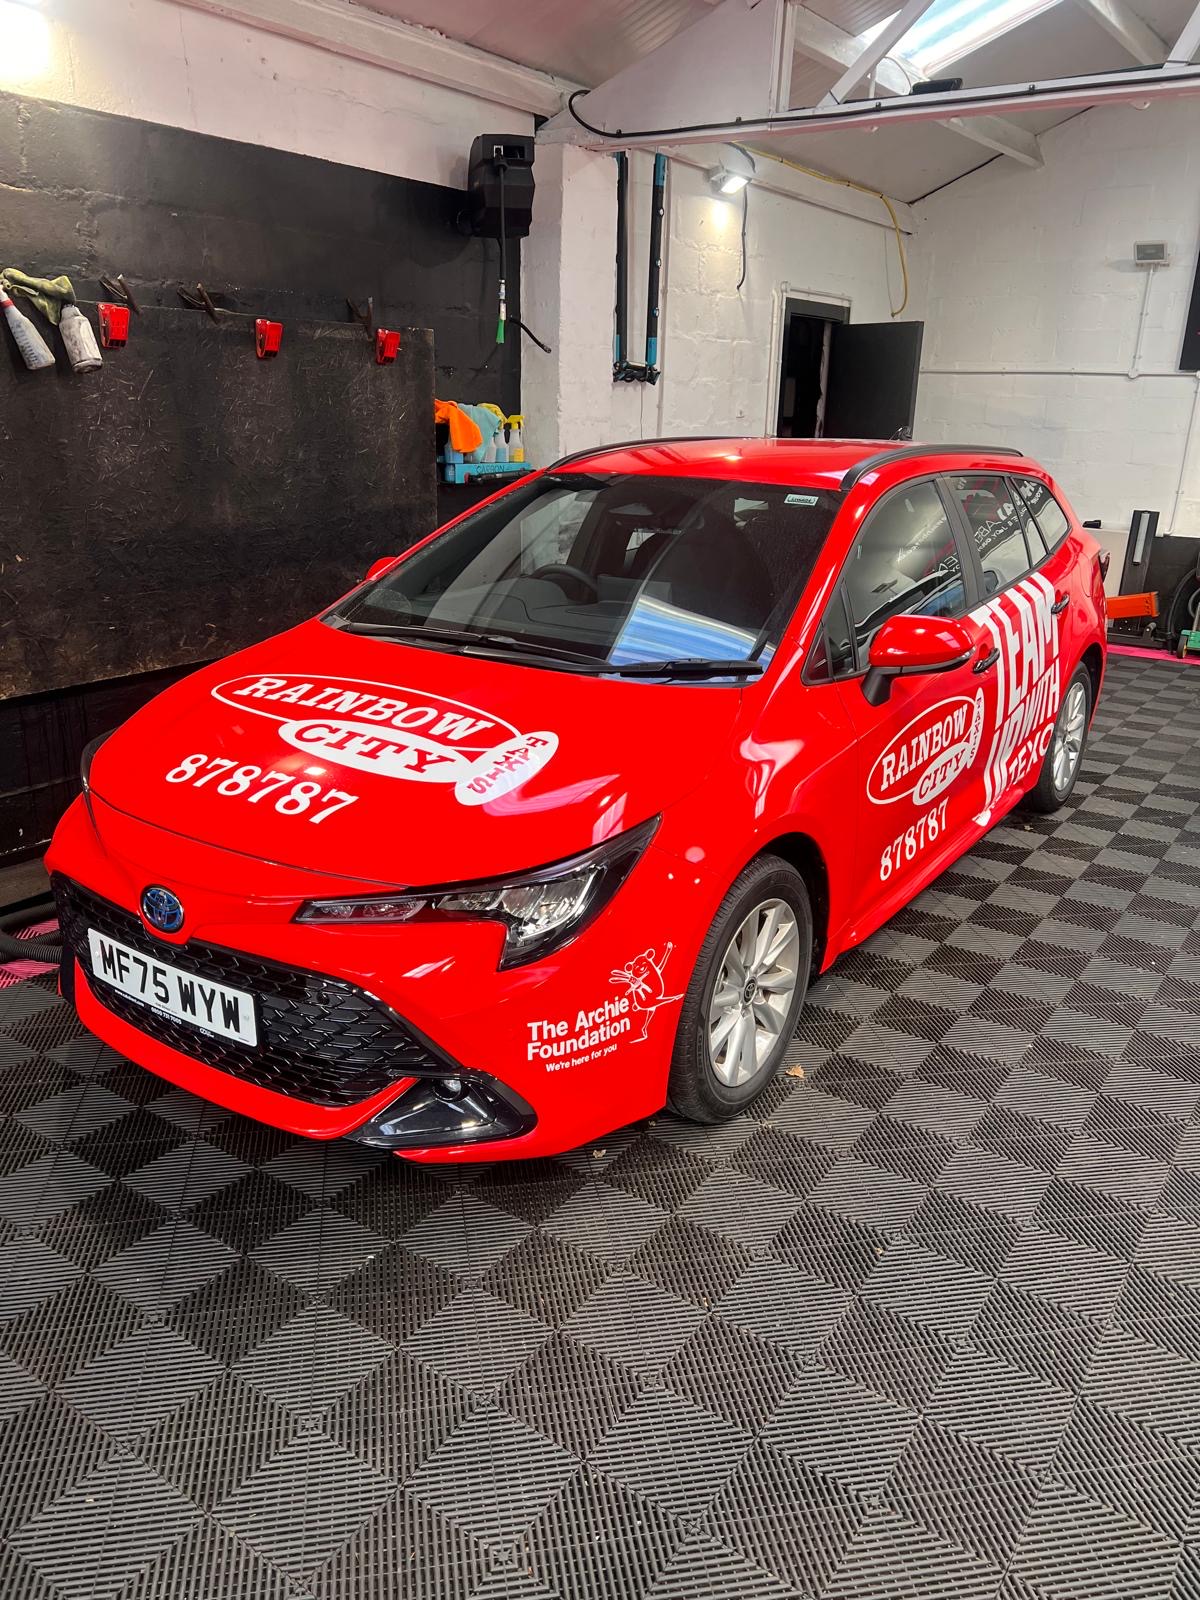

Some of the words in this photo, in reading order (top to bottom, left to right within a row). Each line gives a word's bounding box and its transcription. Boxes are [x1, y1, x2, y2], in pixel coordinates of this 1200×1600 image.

[968, 572, 1060, 725] TEAM
[234, 676, 498, 742] RAINBOW
[968, 696, 983, 760] TAXIS
[1020, 657, 1060, 747] WITH
[293, 723, 456, 774] CITY
[465, 735, 548, 795] TAXIS
[880, 703, 968, 792] RAINBOW
[920, 747, 967, 798] CITY
[1007, 723, 1055, 789] TEXO
[165, 752, 360, 825] 878787
[879, 799, 949, 882] 878787
[99, 939, 170, 1004] MF75
[176, 976, 241, 1034] WYW
[527, 1020, 569, 1042] The
[575, 996, 630, 1032] Archie
[527, 1017, 631, 1061] Foundation
[545, 1058, 571, 1072] We're
[571, 1052, 590, 1067] here
[590, 1049, 602, 1060] for
[602, 1043, 618, 1058] you
